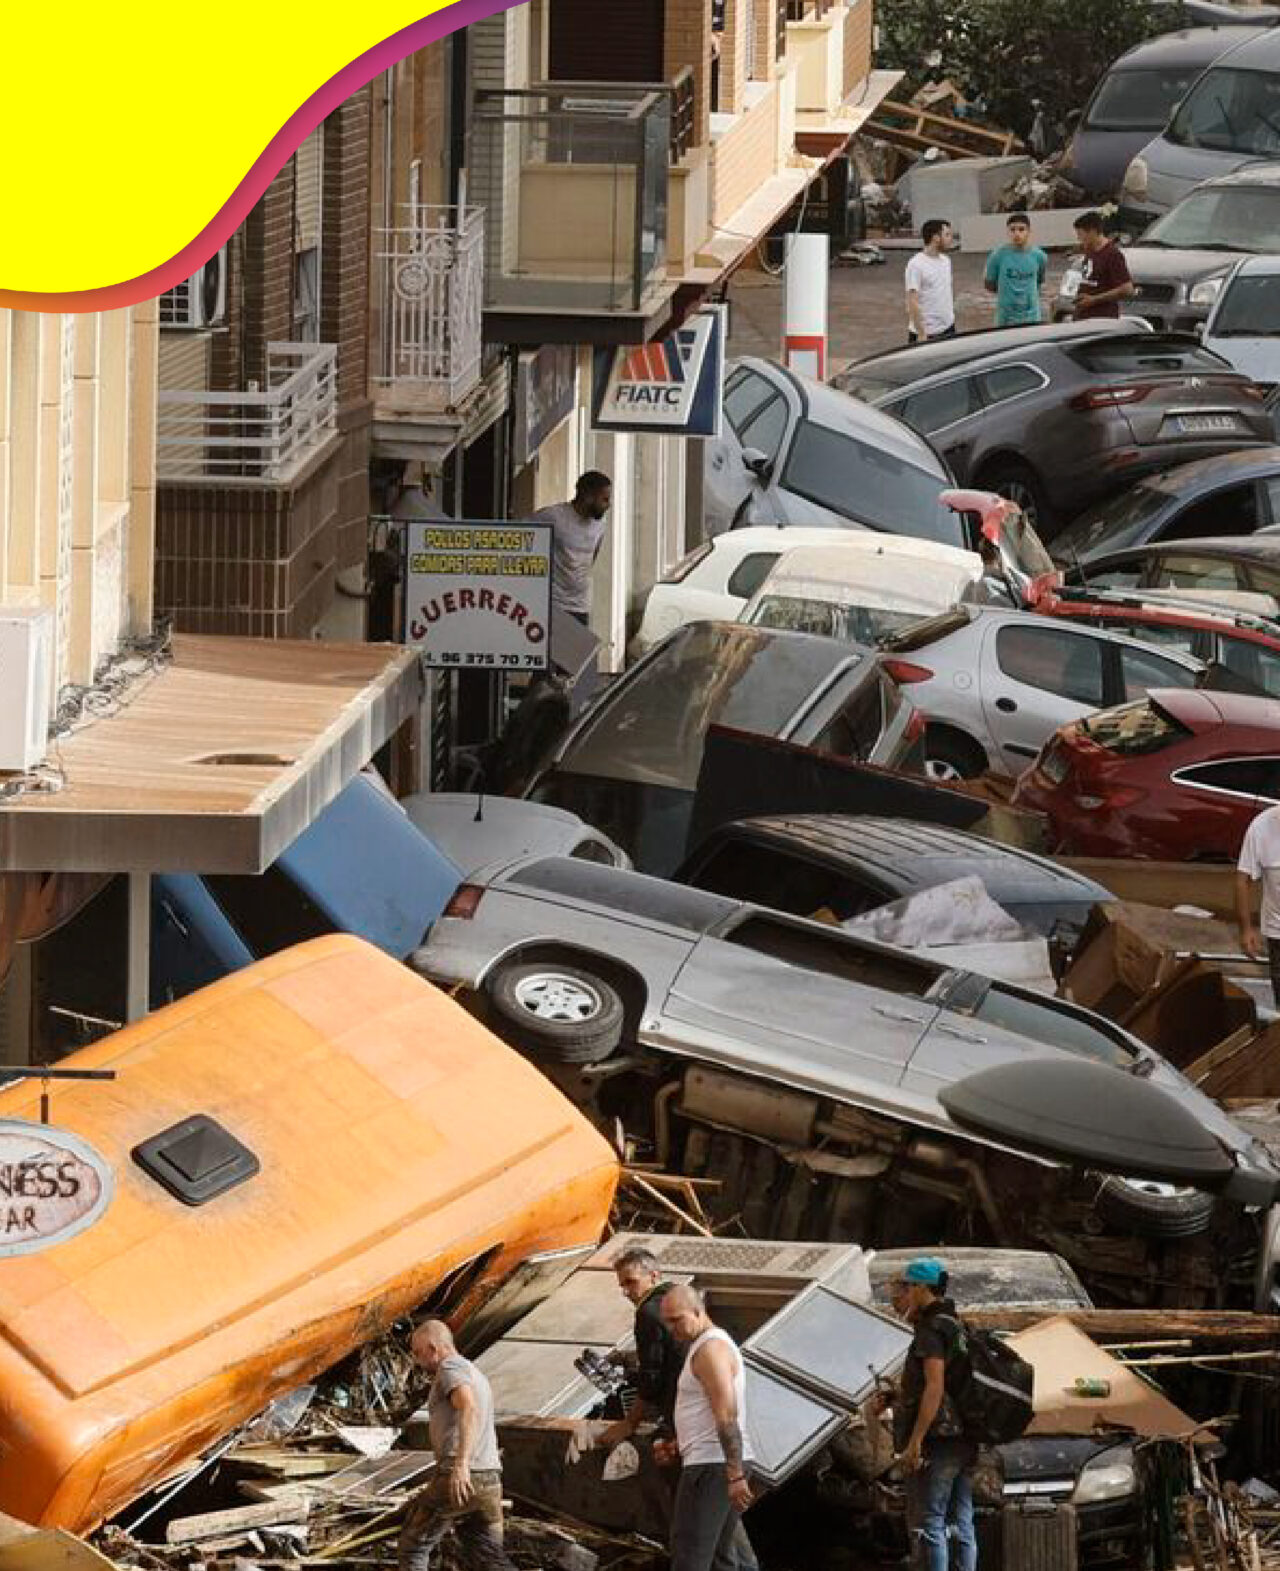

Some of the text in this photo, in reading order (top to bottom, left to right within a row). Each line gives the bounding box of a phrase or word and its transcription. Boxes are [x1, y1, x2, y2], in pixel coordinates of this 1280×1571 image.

[616, 386, 682, 403] FIATC
[424, 529, 471, 549] POLLOS
[472, 530, 522, 550] ASADOS
[466, 555, 499, 575] PARA
[502, 555, 548, 577] LLEVAR
[410, 587, 544, 643] GUERRERO
[465, 653, 495, 665] 375
[500, 654, 519, 665] 70
[0, 1206, 38, 1233] AR
